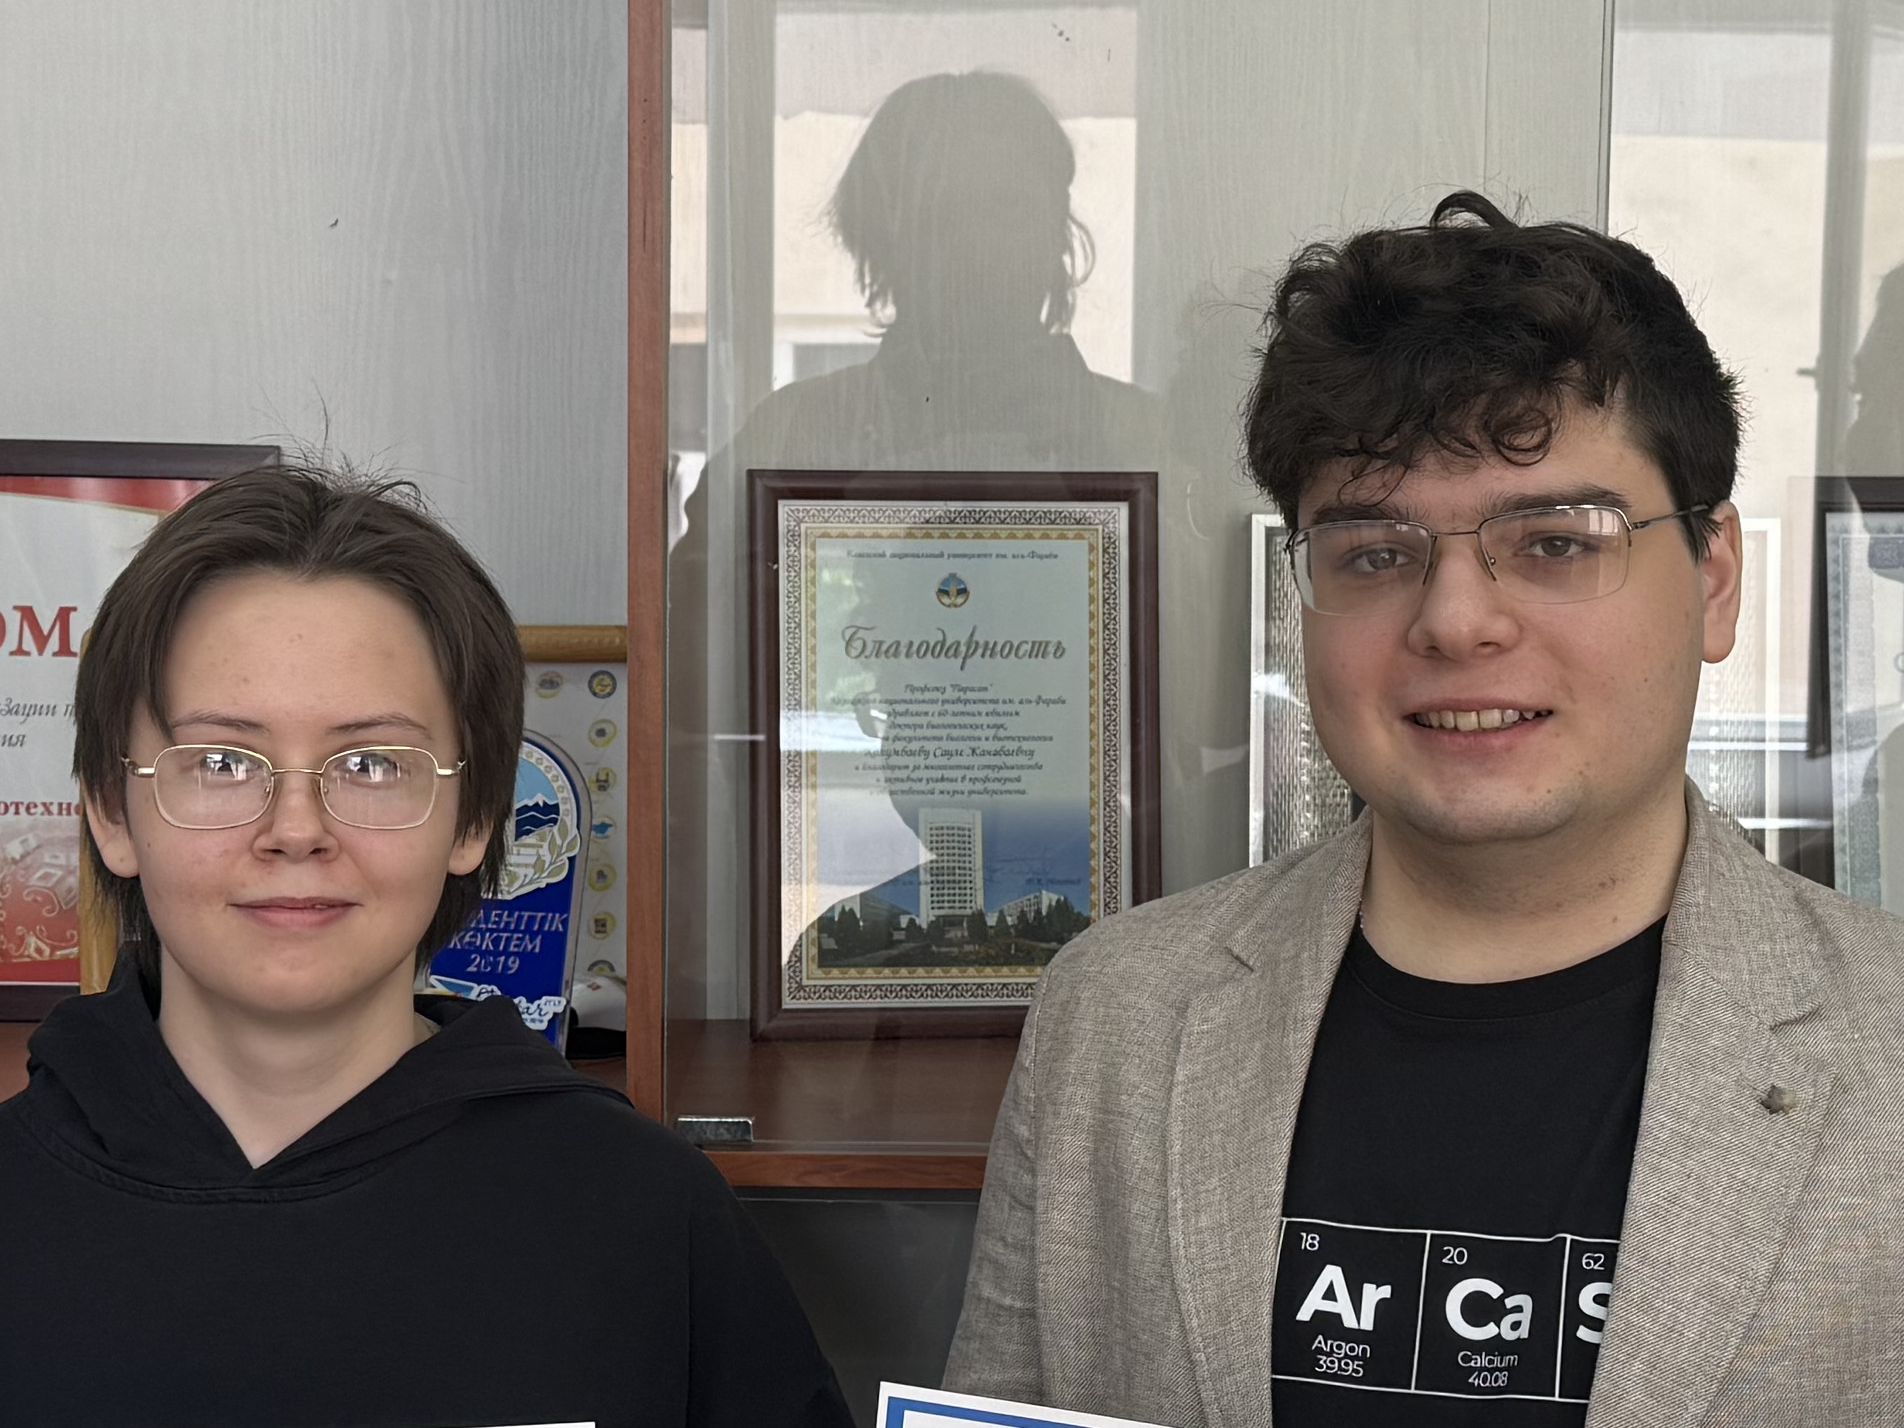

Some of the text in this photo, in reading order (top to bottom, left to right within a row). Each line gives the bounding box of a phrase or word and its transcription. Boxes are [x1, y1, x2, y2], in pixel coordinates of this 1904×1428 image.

[841, 625, 1066, 671] Благодарность
[466, 953, 520, 974] 2019
[1299, 1232, 1320, 1251] 18
[1441, 1246, 1468, 1266] 20
[1582, 1253, 1605, 1271] 62
[1295, 1263, 1391, 1332] Ar
[1445, 1277, 1534, 1342] Ca
[1311, 1335, 1371, 1359] Argon
[1458, 1350, 1519, 1369] Calcium
